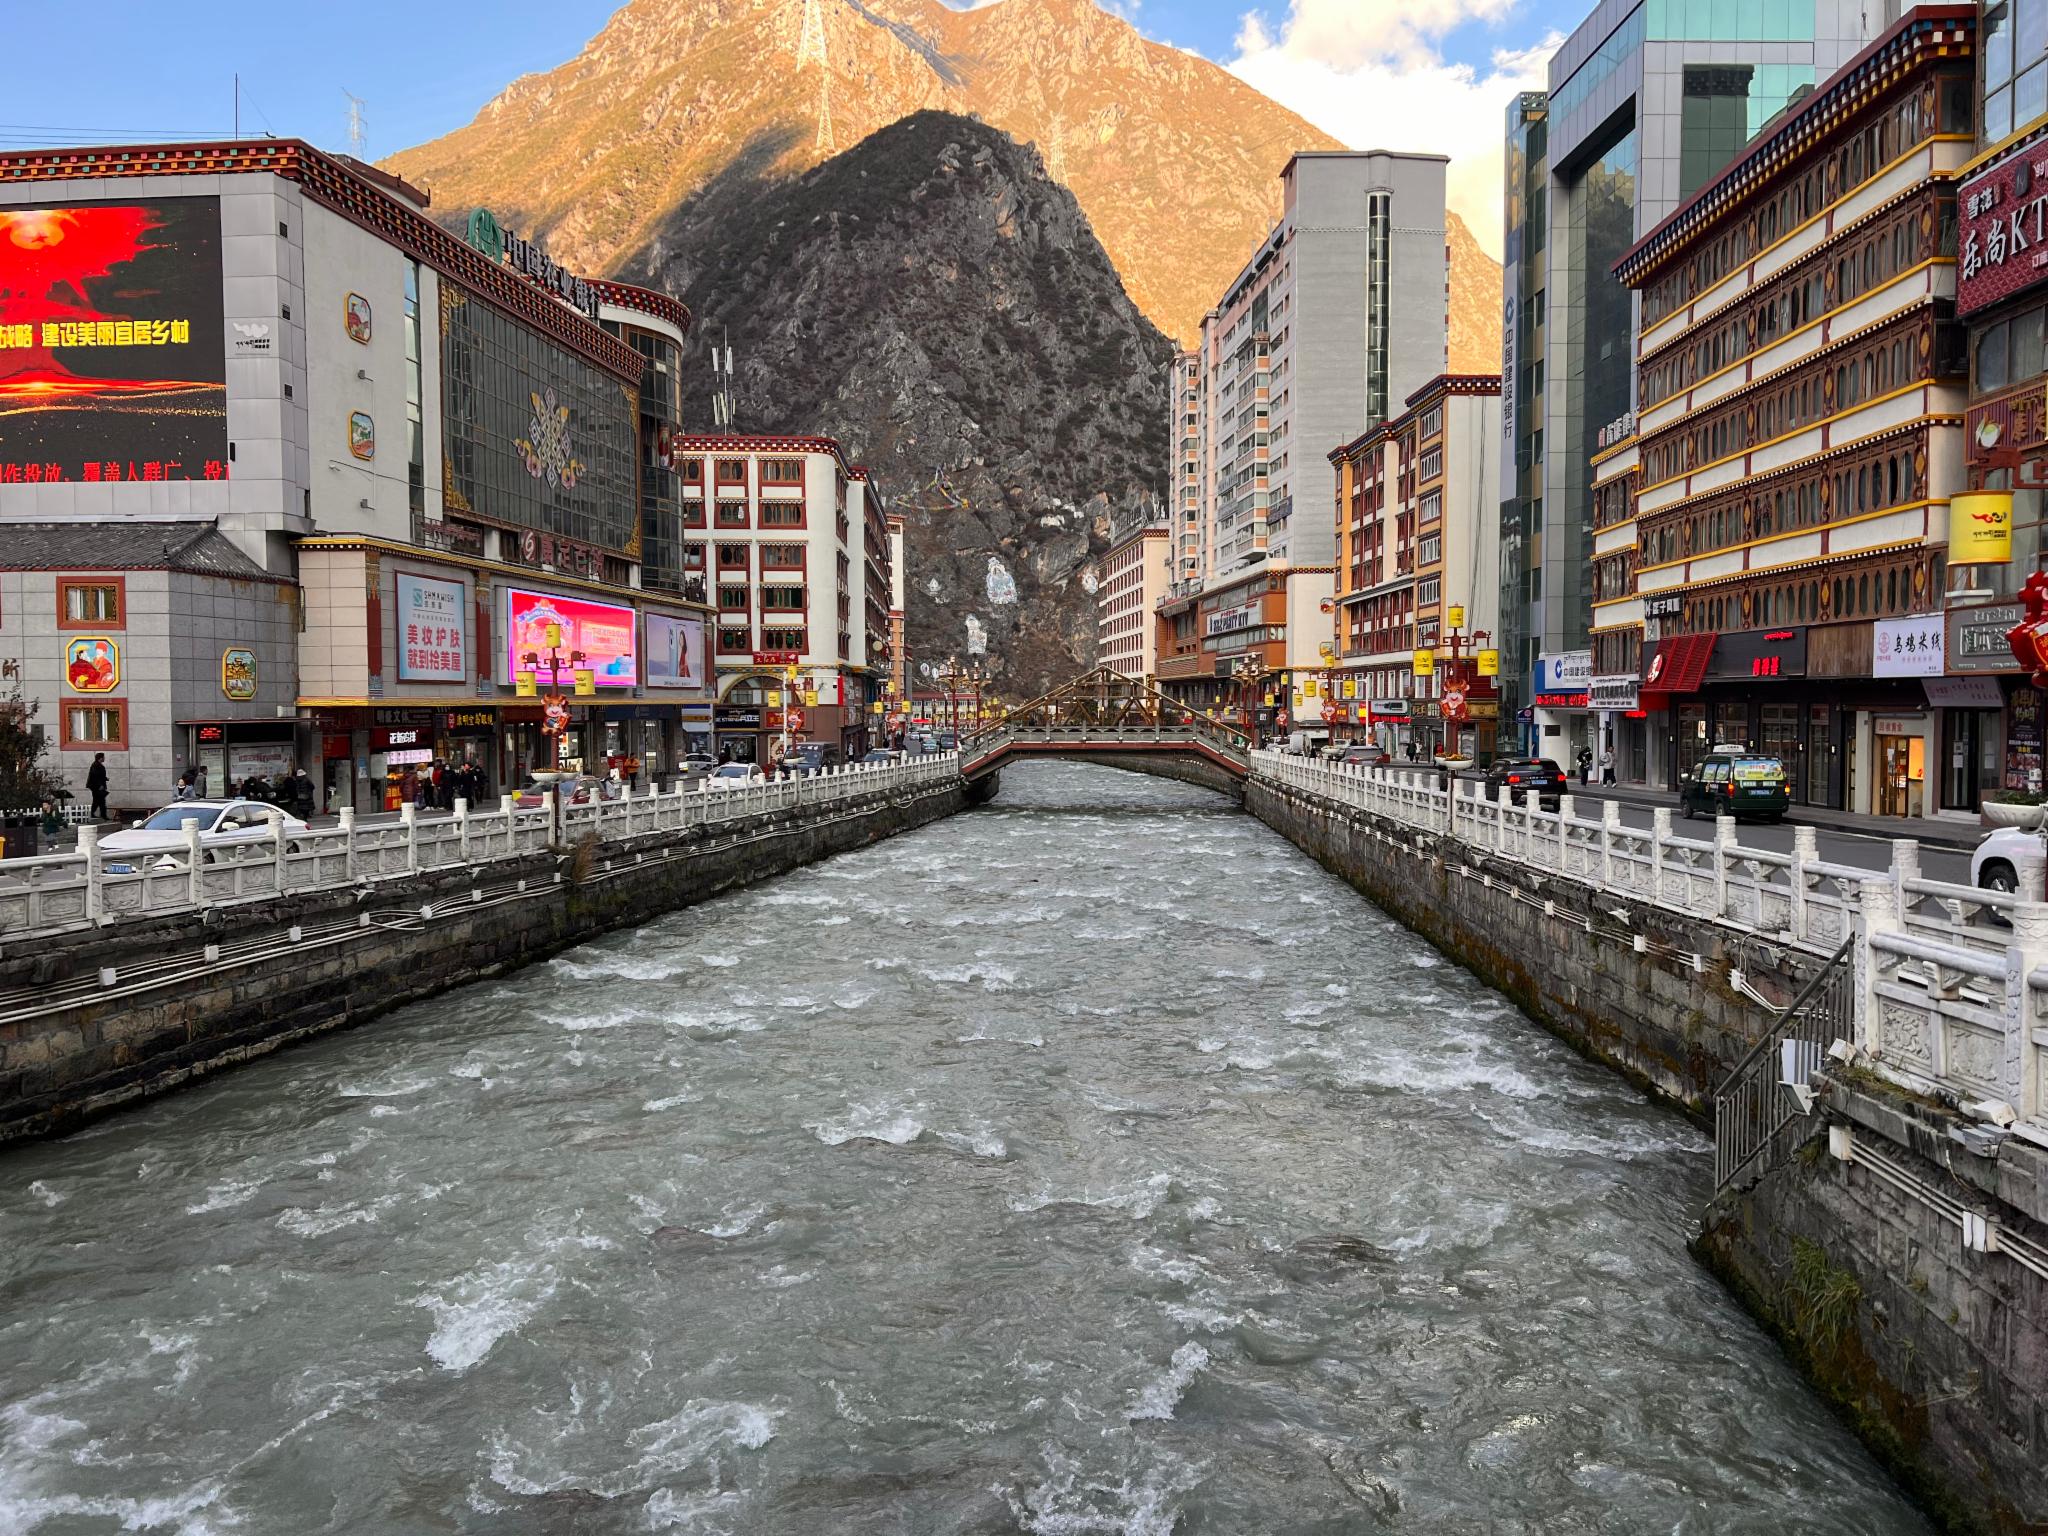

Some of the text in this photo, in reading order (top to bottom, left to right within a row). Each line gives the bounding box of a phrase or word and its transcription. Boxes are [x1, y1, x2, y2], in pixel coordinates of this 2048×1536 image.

[507, 231, 600, 321] 中国农业银行
[42, 319, 189, 347] 建设美丽宜居乡村
[407, 623, 460, 648] 美妆护肤
[1893, 631, 1941, 654] 乌鸡米线
[2, 657, 20, 684] 所
[407, 648, 461, 671] 就到拾美屋
